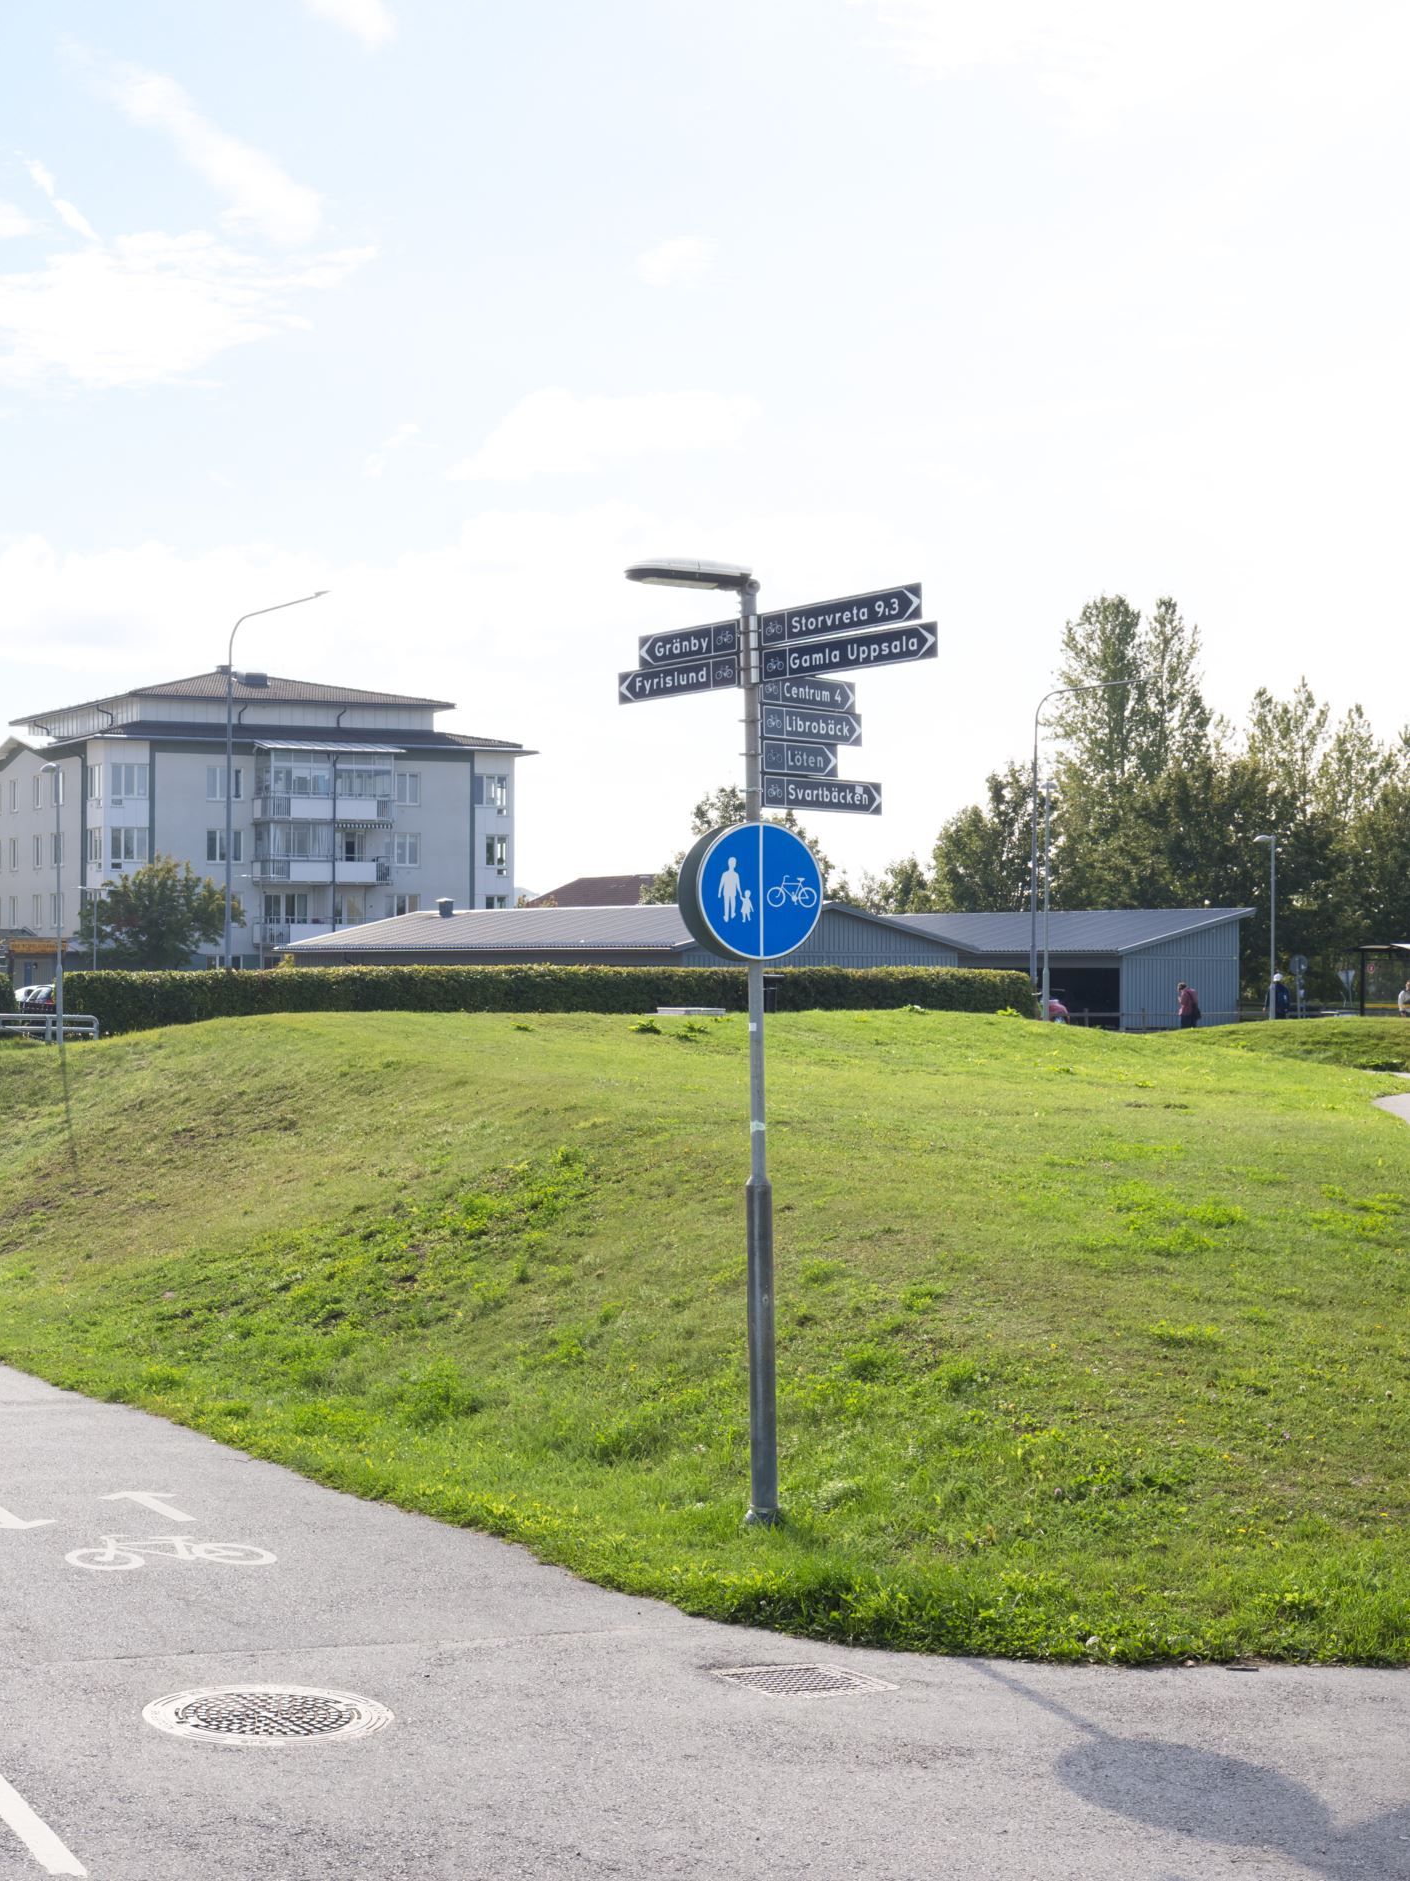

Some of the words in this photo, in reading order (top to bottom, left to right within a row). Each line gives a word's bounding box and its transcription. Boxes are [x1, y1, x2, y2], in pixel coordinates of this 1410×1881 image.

[791, 605, 868, 633] Storvreta
[654, 636, 709, 657] Gränby
[789, 647, 840, 669] Gamla
[847, 635, 918, 662] Uppsala
[635, 667, 707, 695] Fyrislund
[784, 682, 831, 702] Centrum
[834, 688, 842, 703] 4
[786, 715, 850, 737] Librobäck
[788, 750, 824, 768] Löten
[788, 784, 869, 805] Svartbäcken
